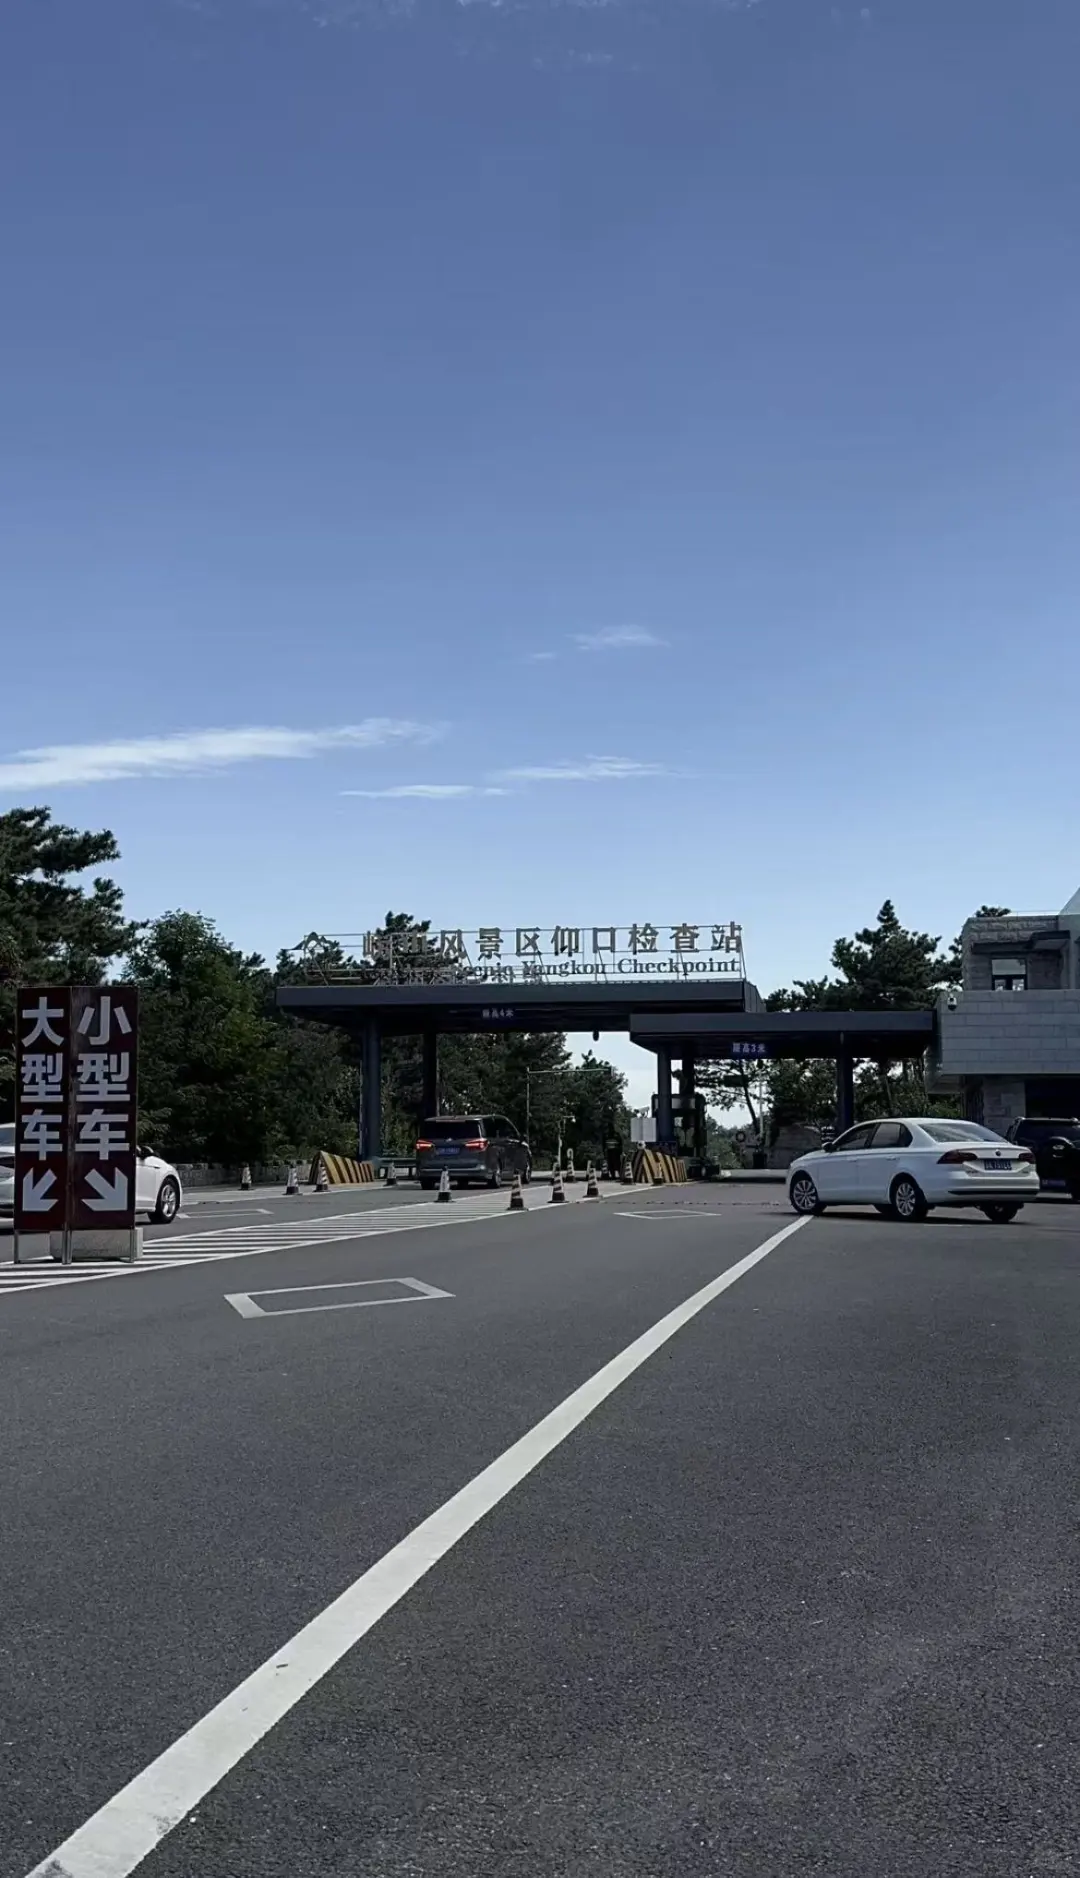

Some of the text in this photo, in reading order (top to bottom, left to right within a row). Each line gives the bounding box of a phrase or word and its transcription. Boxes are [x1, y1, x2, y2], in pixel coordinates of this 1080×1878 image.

[522, 960, 606, 977] Yangkou
[617, 957, 739, 976] Checkpoint
[20, 997, 64, 1160] 大型车
[76, 996, 132, 1160] 小型车
